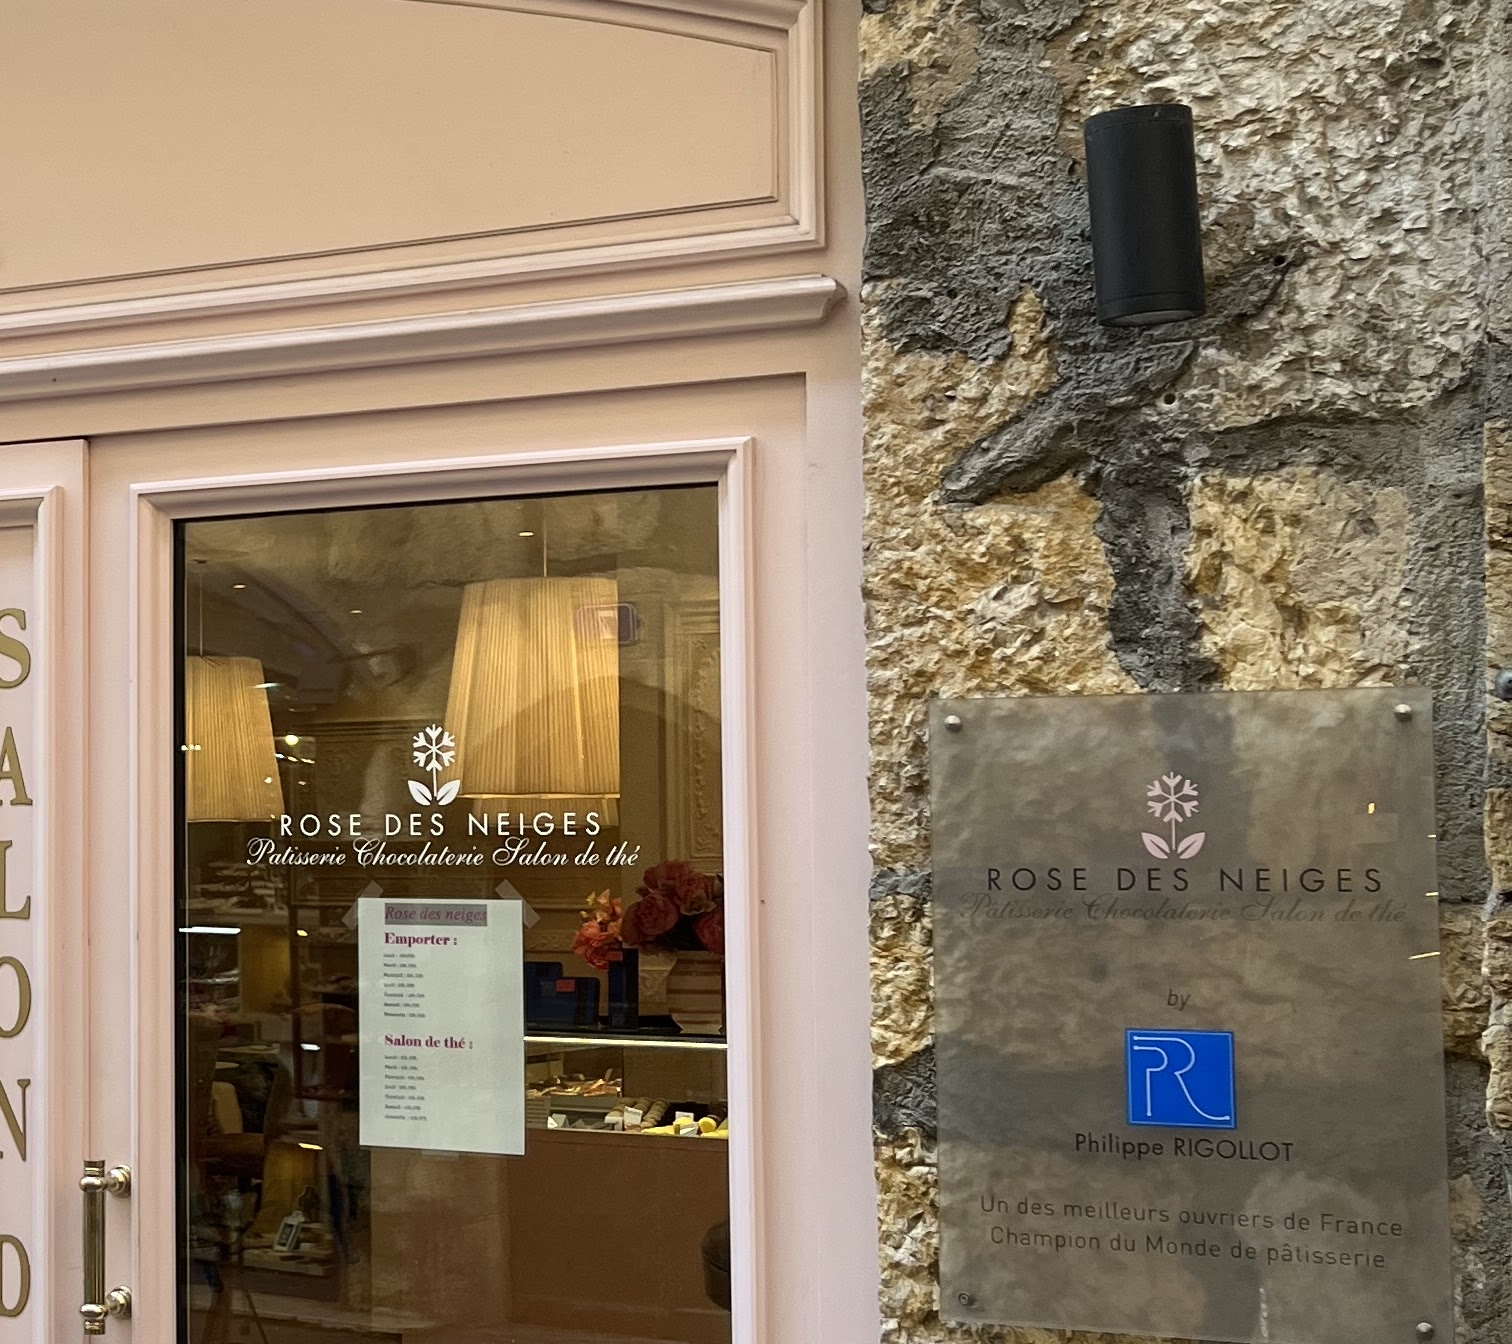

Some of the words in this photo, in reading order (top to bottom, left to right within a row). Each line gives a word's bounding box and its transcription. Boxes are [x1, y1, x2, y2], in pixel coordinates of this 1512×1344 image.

[280, 814, 362, 837] ROSE
[385, 813, 444, 836] DES
[468, 812, 600, 836] NEIGES
[246, 837, 347, 866] Patisserie
[352, 837, 484, 869] Chocolaterie
[492, 836, 569, 867] Salon
[574, 841, 600, 866] de
[605, 841, 641, 866] thé
[988, 868, 1088, 891] ROSE
[1117, 868, 1189, 892] DES
[1220, 868, 1382, 893] NEIGES
[385, 906, 416, 920] Rose
[419, 907, 441, 921] des
[445, 906, 487, 925] neiges
[1082, 893, 1231, 921] Chocolaterie
[1240, 895, 1325, 922] Salon
[1334, 898, 1363, 922] de
[1368, 898, 1406, 923] thé
[384, 932, 450, 948] Emporter
[1167, 989, 1191, 1011] by
[384, 1034, 422, 1047] Salon
[425, 1035, 441, 1048] de
[444, 1036, 466, 1049] thé
[1075, 1132, 1164, 1160] Philippe
[1174, 1137, 1294, 1162] RIGOLLOT
[981, 1194, 1009, 1213] Un
[1017, 1197, 1055, 1216] des
[1063, 1201, 1170, 1223] meilleurs
[1179, 1208, 1274, 1229] ouvriers
[1284, 1212, 1310, 1230] de
[1320, 1213, 1403, 1237] France
[991, 1226, 1100, 1252] Champion
[1110, 1234, 1136, 1252] du
[1146, 1235, 1221, 1257] Monde
[1230, 1240, 1257, 1259] de
[1267, 1243, 1385, 1268] pâtisserie
